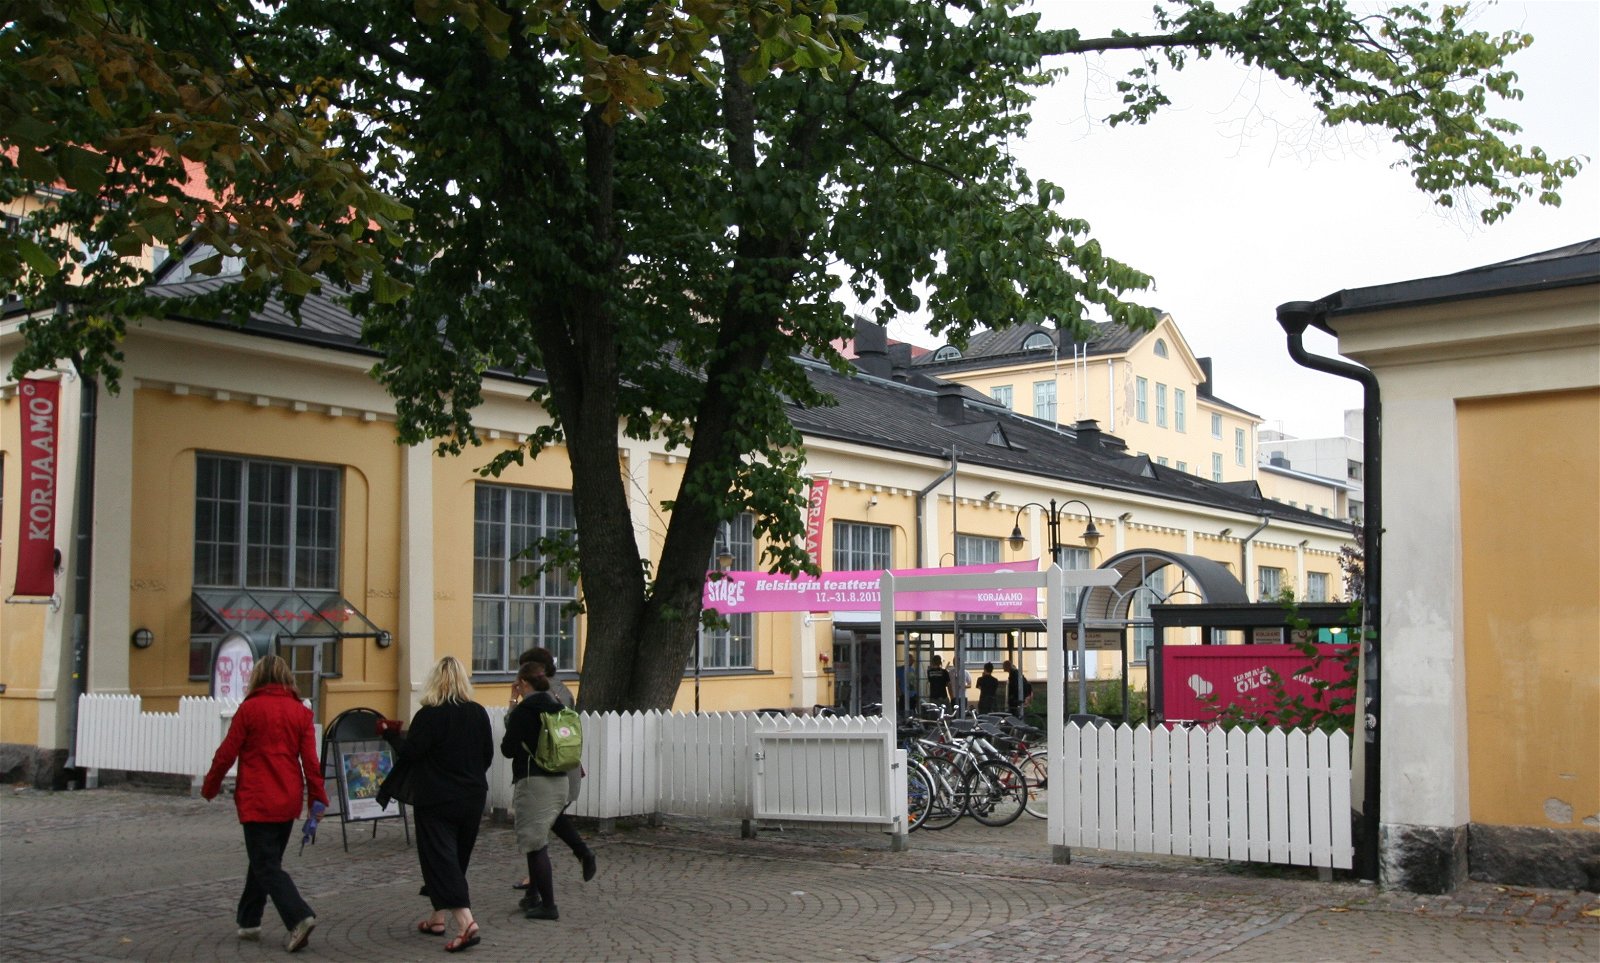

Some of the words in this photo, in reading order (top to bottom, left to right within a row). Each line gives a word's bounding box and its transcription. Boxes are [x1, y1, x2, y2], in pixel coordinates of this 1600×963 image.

[29, 397, 53, 541] KORJAAMO
[806, 486, 824, 564] KORJAAM
[756, 579, 821, 593] Helsingin
[977, 593, 1023, 602] KORJAAMO
